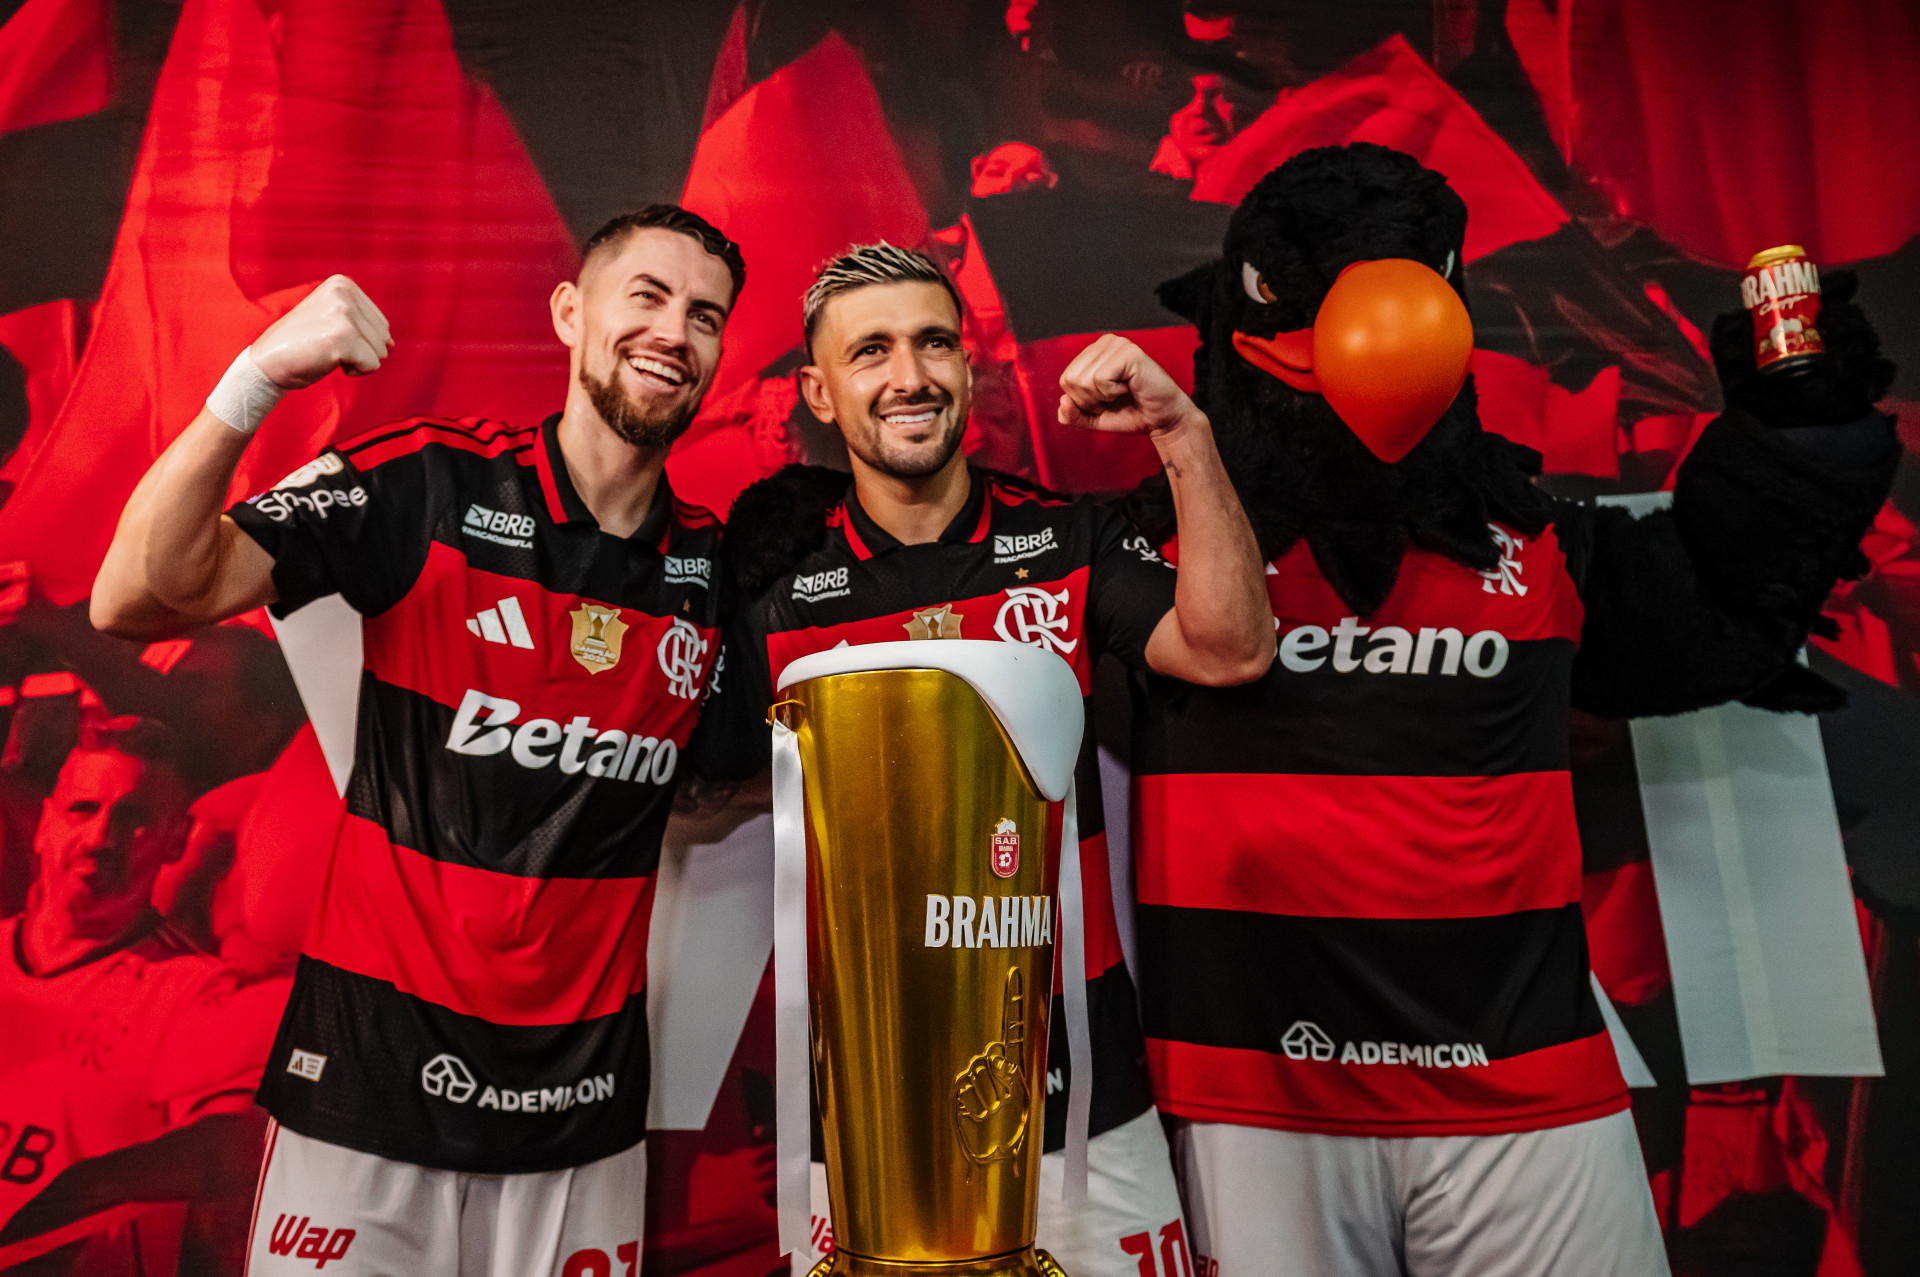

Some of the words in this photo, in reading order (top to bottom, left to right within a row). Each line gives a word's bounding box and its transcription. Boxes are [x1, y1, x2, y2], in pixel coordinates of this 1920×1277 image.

[1741, 262, 1821, 310] RAHM
[489, 511, 536, 538] BRB
[1015, 527, 1054, 553] BRB
[813, 567, 849, 592] BRB
[1274, 616, 1510, 678] etano
[445, 688, 677, 786] Betano
[924, 894, 1053, 949] BRAHMA
[1340, 1041, 1489, 1069] ADEMICON
[268, 1213, 357, 1270] Wap
